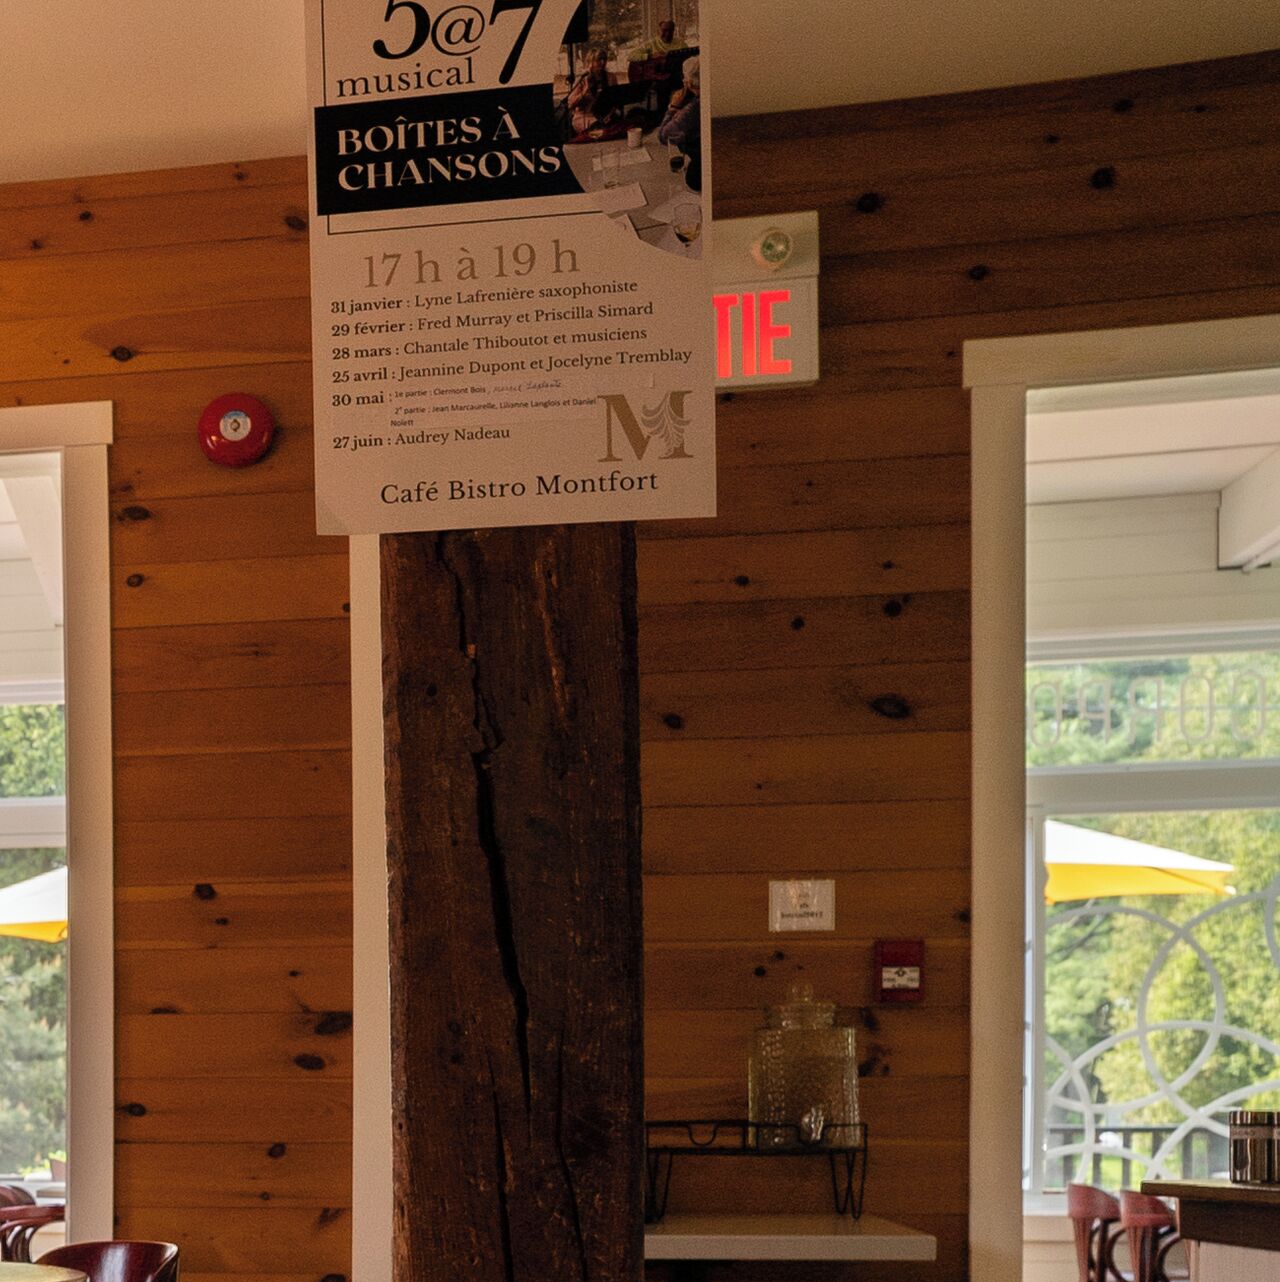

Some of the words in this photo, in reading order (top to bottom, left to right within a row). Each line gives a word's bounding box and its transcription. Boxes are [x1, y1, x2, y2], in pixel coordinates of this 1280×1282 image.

[373, 0, 542, 84] 5@7
[337, 57, 475, 97] musical
[337, 116, 482, 156] BOÎTES
[492, 105, 521, 141] À
[338, 146, 561, 191] CHANSONS
[364, 252, 401, 289] 17
[415, 250, 442, 284] h
[456, 248, 479, 281] à
[494, 242, 536, 278] 19
[552, 239, 580, 273] h
[331, 301, 346, 314] 31
[348, 297, 403, 315] janvier
[415, 294, 453, 310] Lyne
[456, 287, 535, 305] Lafrenière
[539, 280, 638, 299] saxophoniste
[331, 324, 350, 337] 29
[354, 320, 406, 335] février
[417, 316, 451, 331] Fred
[456, 314, 513, 329] Murray
[516, 311, 530, 323] et
[534, 305, 593, 322] Priscilla
[597, 302, 653, 318] Simard
[332, 347, 350, 360] 28
[354, 346, 391, 359] mars
[403, 338, 469, 355] Chantale
[473, 333, 549, 350] Thiboutot
[553, 333, 567, 345] et
[571, 327, 647, 343] musiciens
[332, 371, 350, 384] 25
[353, 367, 388, 383] avril
[398, 363, 464, 383] Jeannine
[469, 358, 526, 378] Dupont
[530, 357, 543, 370] et
[546, 354, 613, 373] Jocelyne
[616, 348, 692, 366] Tremblay
[332, 394, 351, 407] 30
[356, 391, 385, 406] mai
[405, 389, 427, 399] partie
[433, 386, 469, 396] Clermont
[404, 406, 426, 416] partie
[431, 405, 449, 414] Jean
[531, 399, 561, 409] Langlois
[563, 399, 571, 407] et
[573, 398, 596, 406] Daniel
[333, 437, 349, 449] 27
[351, 434, 383, 452] juin
[395, 430, 449, 446] Audrey
[454, 426, 510, 442] Nadeau
[381, 481, 438, 504] Café
[449, 478, 526, 500] Bistro
[536, 470, 658, 496] Montfort
